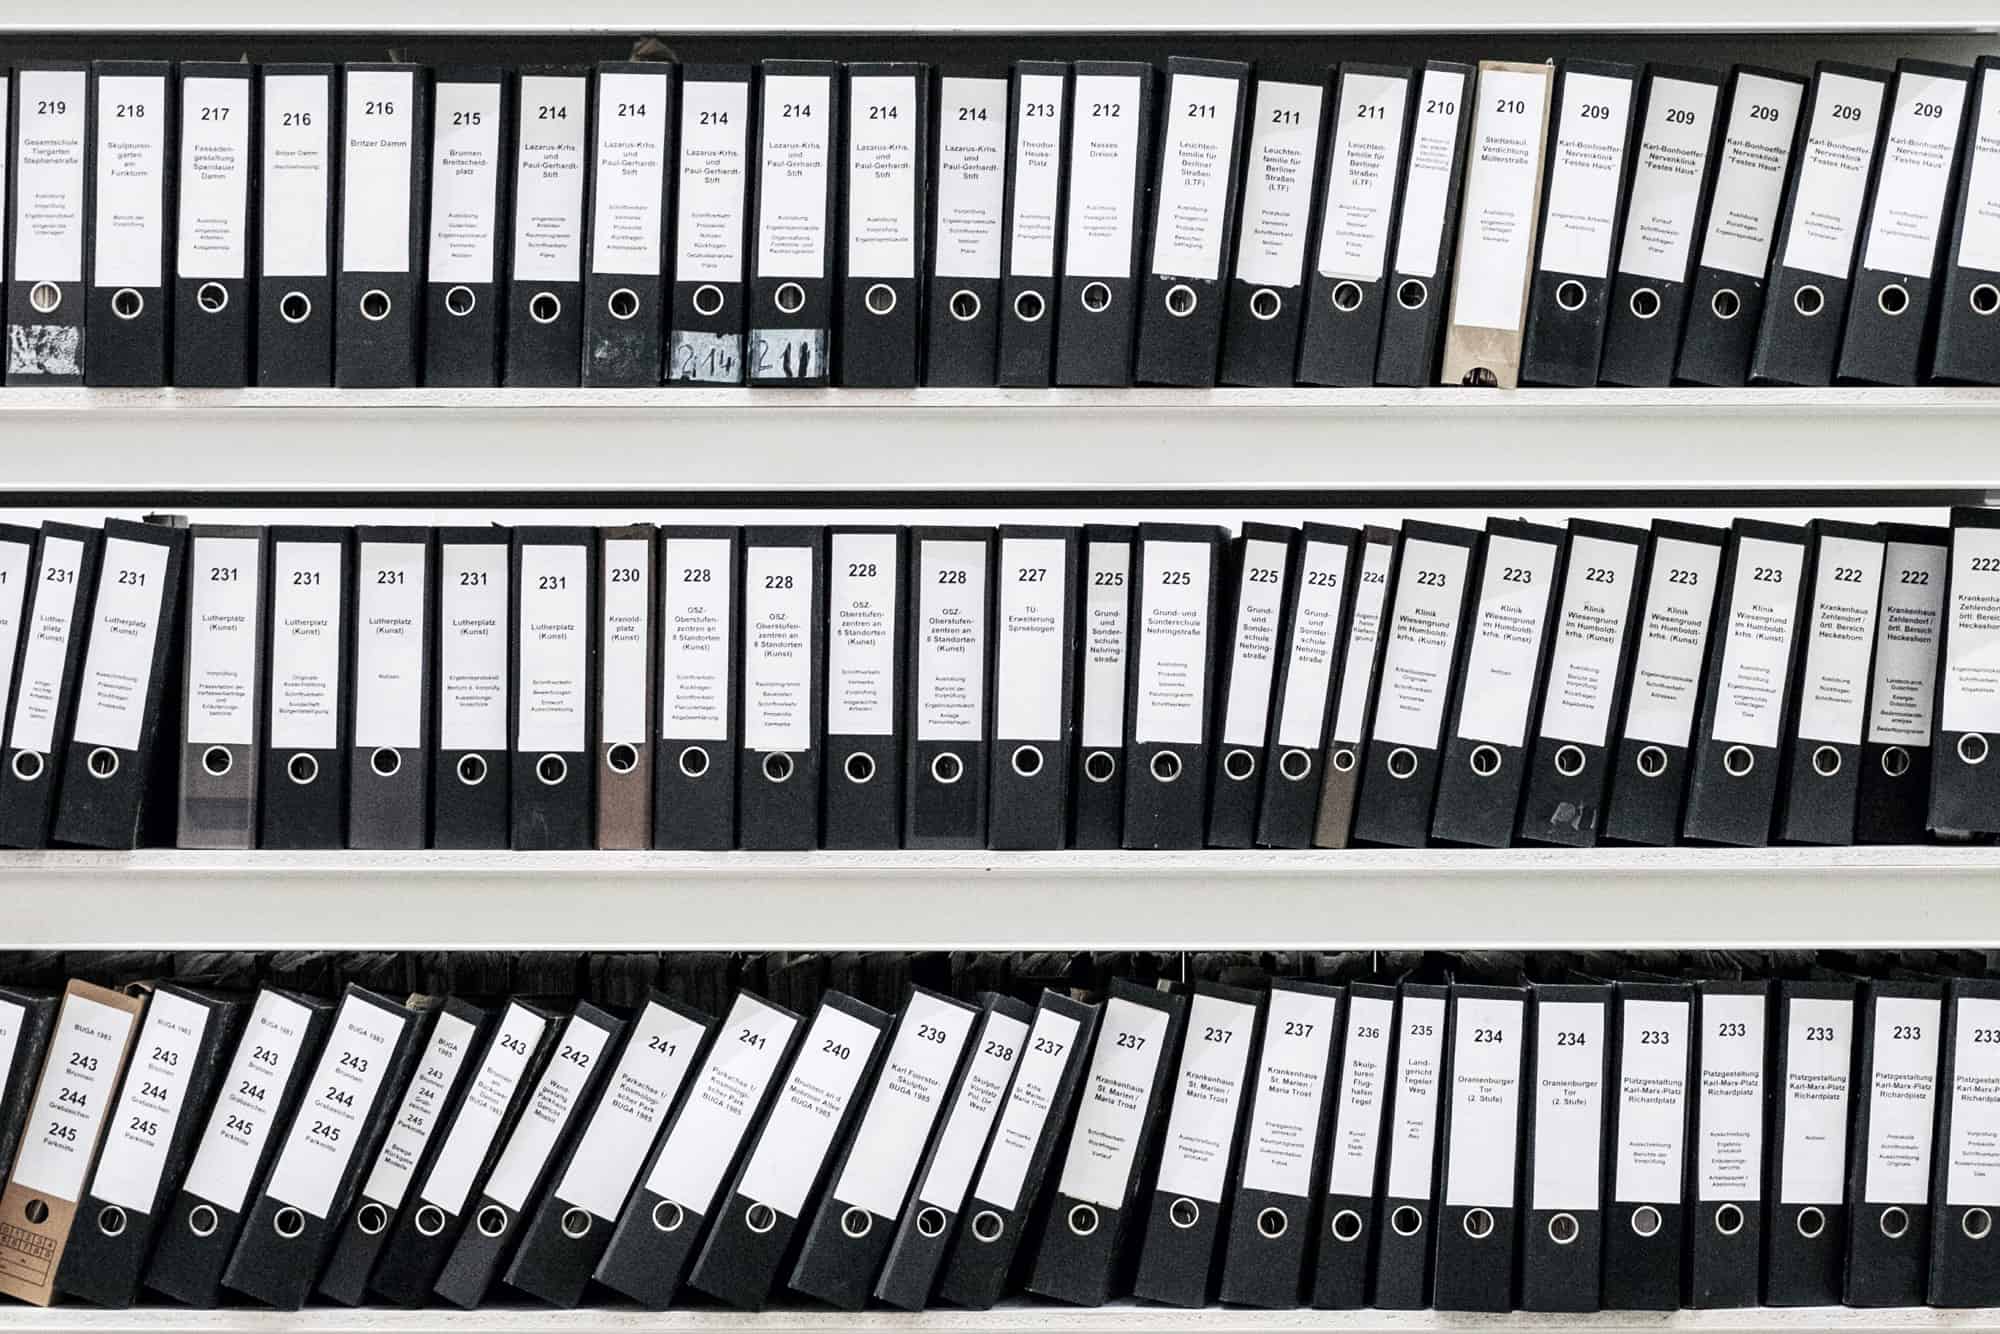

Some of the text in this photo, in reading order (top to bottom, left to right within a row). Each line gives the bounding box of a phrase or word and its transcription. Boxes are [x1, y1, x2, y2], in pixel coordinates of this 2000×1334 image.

[38, 101, 65, 114] 219
[117, 105, 144, 117] 218
[201, 107, 229, 120] 217
[366, 102, 393, 115] 216
[539, 106, 566, 119] 214
[618, 104, 645, 116] 214
[783, 104, 810, 117] 214
[870, 106, 897, 119] 214
[959, 108, 987, 120] 214
[1026, 104, 1054, 117] 213
[1093, 104, 1120, 117] 212
[1188, 104, 1215, 118] 211
[1358, 105, 1384, 119] 211
[1427, 100, 1454, 115] 210
[1496, 100, 1524, 114] 210
[1581, 104, 1609, 119] 209
[1750, 105, 1778, 121] 209
[1832, 105, 1861, 120] 209
[1914, 103, 1942, 118] 209
[283, 113, 311, 126] 216
[453, 112, 480, 125] 215
[700, 112, 728, 125] 214
[1272, 110, 1299, 124] 211
[1666, 109, 1695, 125] 209
[351, 139, 407, 148] Britzer Damm
[849, 564, 876, 577] 228
[1972, 558, 2000, 572] 222
[47, 568, 73, 584] 231
[118, 570, 145, 586] 231
[211, 568, 237, 581] 231
[294, 572, 319, 585] 231
[377, 571, 403, 584] 231
[461, 572, 486, 585] 231
[612, 569, 639, 582] 230
[684, 569, 711, 582] 228
[939, 571, 966, 584] 228
[1019, 568, 1046, 582] 227
[1095, 572, 1123, 586] 225
[1163, 571, 1190, 585] 225
[1250, 568, 1278, 583] 225
[1308, 572, 1336, 587] 225
[1364, 572, 1384, 583] 224
[1417, 571, 1445, 587] 223
[1503, 568, 1531, 583] 223
[1586, 568, 1614, 583] 223
[1669, 569, 1698, 585] 223
[1754, 568, 1782, 583] 223
[1835, 568, 1862, 583] 222
[1901, 570, 1929, 585] 222
[539, 576, 565, 589] 231
[765, 576, 793, 589] 228
[1667, 607, 1688, 616] Klinik
[1888, 605, 1937, 617] Krankenhaus
[285, 619, 328, 627] Lutherplatz
[1650, 612, 1702, 628] Wiesengrund
[292, 628, 320, 636] (Kunst)
[848, 638, 875, 646] (Kunst)
[918, 1025, 946, 1044] 239
[1204, 1027, 1232, 1043] 237
[1285, 1022, 1313, 1037] 237
[1358, 1027, 1379, 1038] 236
[1411, 1025, 1432, 1036] 235
[1474, 1029, 1502, 1043] 234
[1719, 1024, 1745, 1037] 233
[1807, 1027, 1834, 1041] 233
[1894, 1026, 1920, 1040] 233
[1974, 1029, 2000, 1043] 233
[501, 1034, 526, 1055] 243
[739, 1029, 766, 1050] 241
[1117, 1033, 1145, 1050] 237
[1558, 1032, 1585, 1046] 234
[1641, 1031, 1669, 1044] 233
[648, 1036, 676, 1056] 241
[823, 1040, 850, 1060] 240
[985, 1041, 1013, 1061] 238
[1035, 1038, 1063, 1056] 237
[69, 1052, 97, 1072] 243
[153, 1047, 178, 1066] 243
[252, 1046, 278, 1067] 243
[340, 1052, 368, 1072] 243
[561, 1046, 589, 1068] 242
[426, 1067, 443, 1081] 243
[1268, 1067, 1317, 1081] Krankenhaus
[1405, 1069, 1432, 1077] gericht
[1790, 1074, 1846, 1083] Platzgestaltung
[1283, 1078, 1307, 1088] Marien
[1458, 1076, 1514, 1086] Oranienburger
[1790, 1083, 1845, 1091] Karl-Marx-Platz
[141, 1082, 167, 1100] 244
[239, 1081, 265, 1102] 244
[417, 1088, 434, 1100] 244
[889, 1082, 913, 1095] BUGA
[1409, 1086, 1426, 1095] Weg
[58, 1088, 86, 1108] 244
[326, 1087, 353, 1108] 244
[1480, 1096, 1502, 1104] Stufe)
[130, 1117, 157, 1136] 245
[225, 1115, 253, 1136] 245
[407, 1114, 423, 1127] 245
[49, 1122, 77, 1141] 245
[311, 1121, 340, 1142] 245
